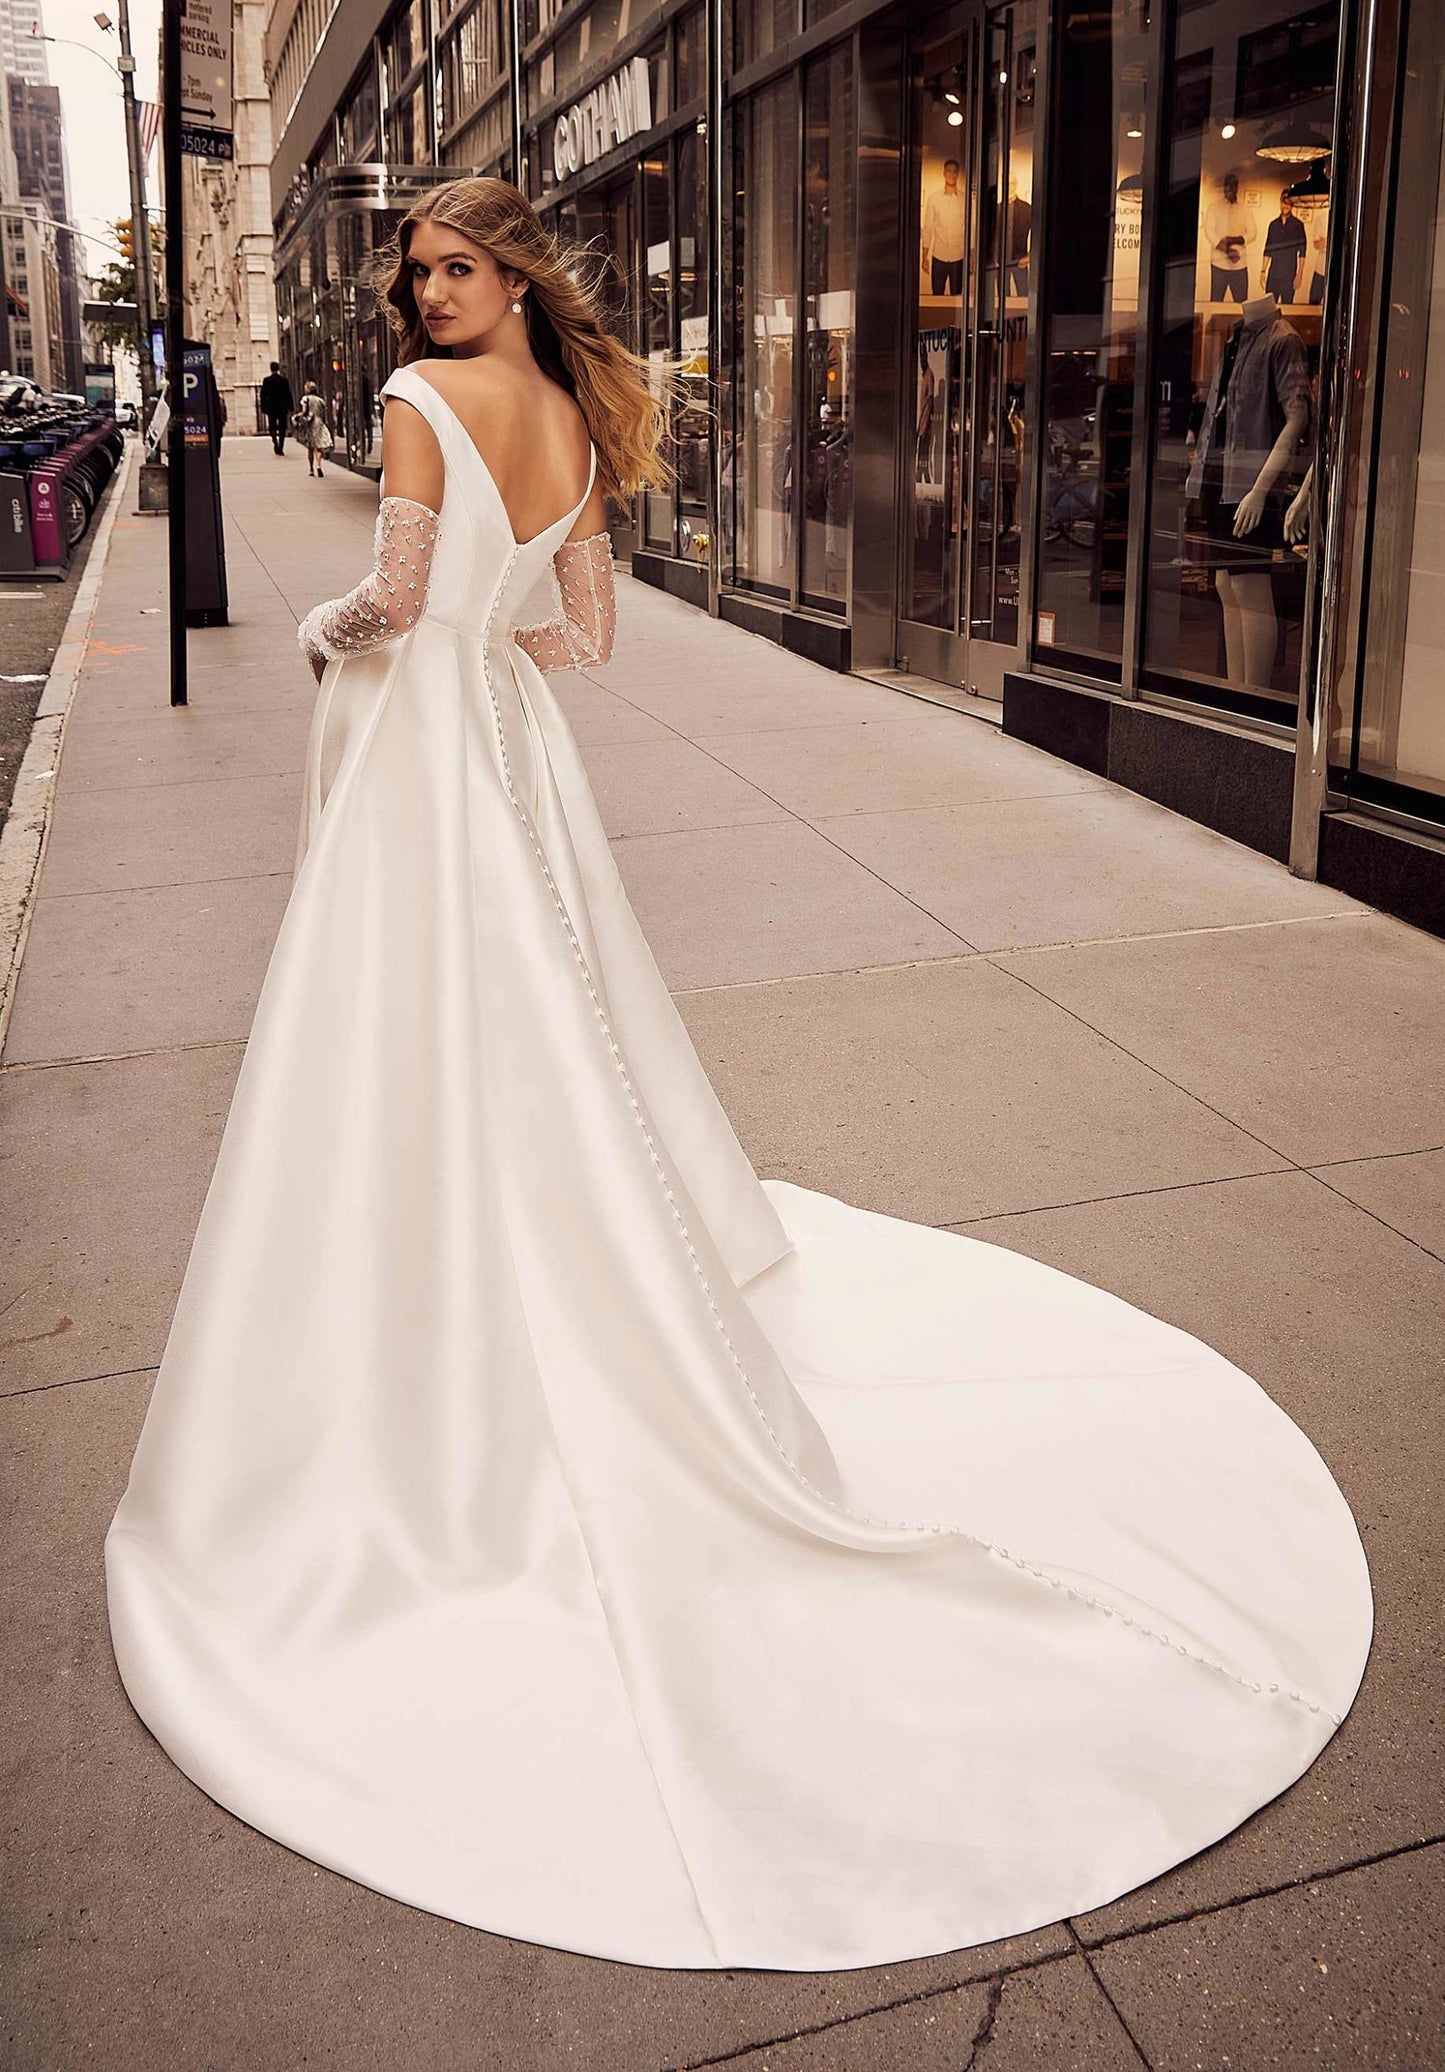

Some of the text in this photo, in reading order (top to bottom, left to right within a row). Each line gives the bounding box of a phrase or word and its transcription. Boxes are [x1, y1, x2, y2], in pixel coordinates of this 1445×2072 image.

[207, 45, 226, 60] ONLY
[190, 88, 213, 103] Sunday
[554, 56, 652, 181] GOTHAM
[183, 373, 199, 398] P
